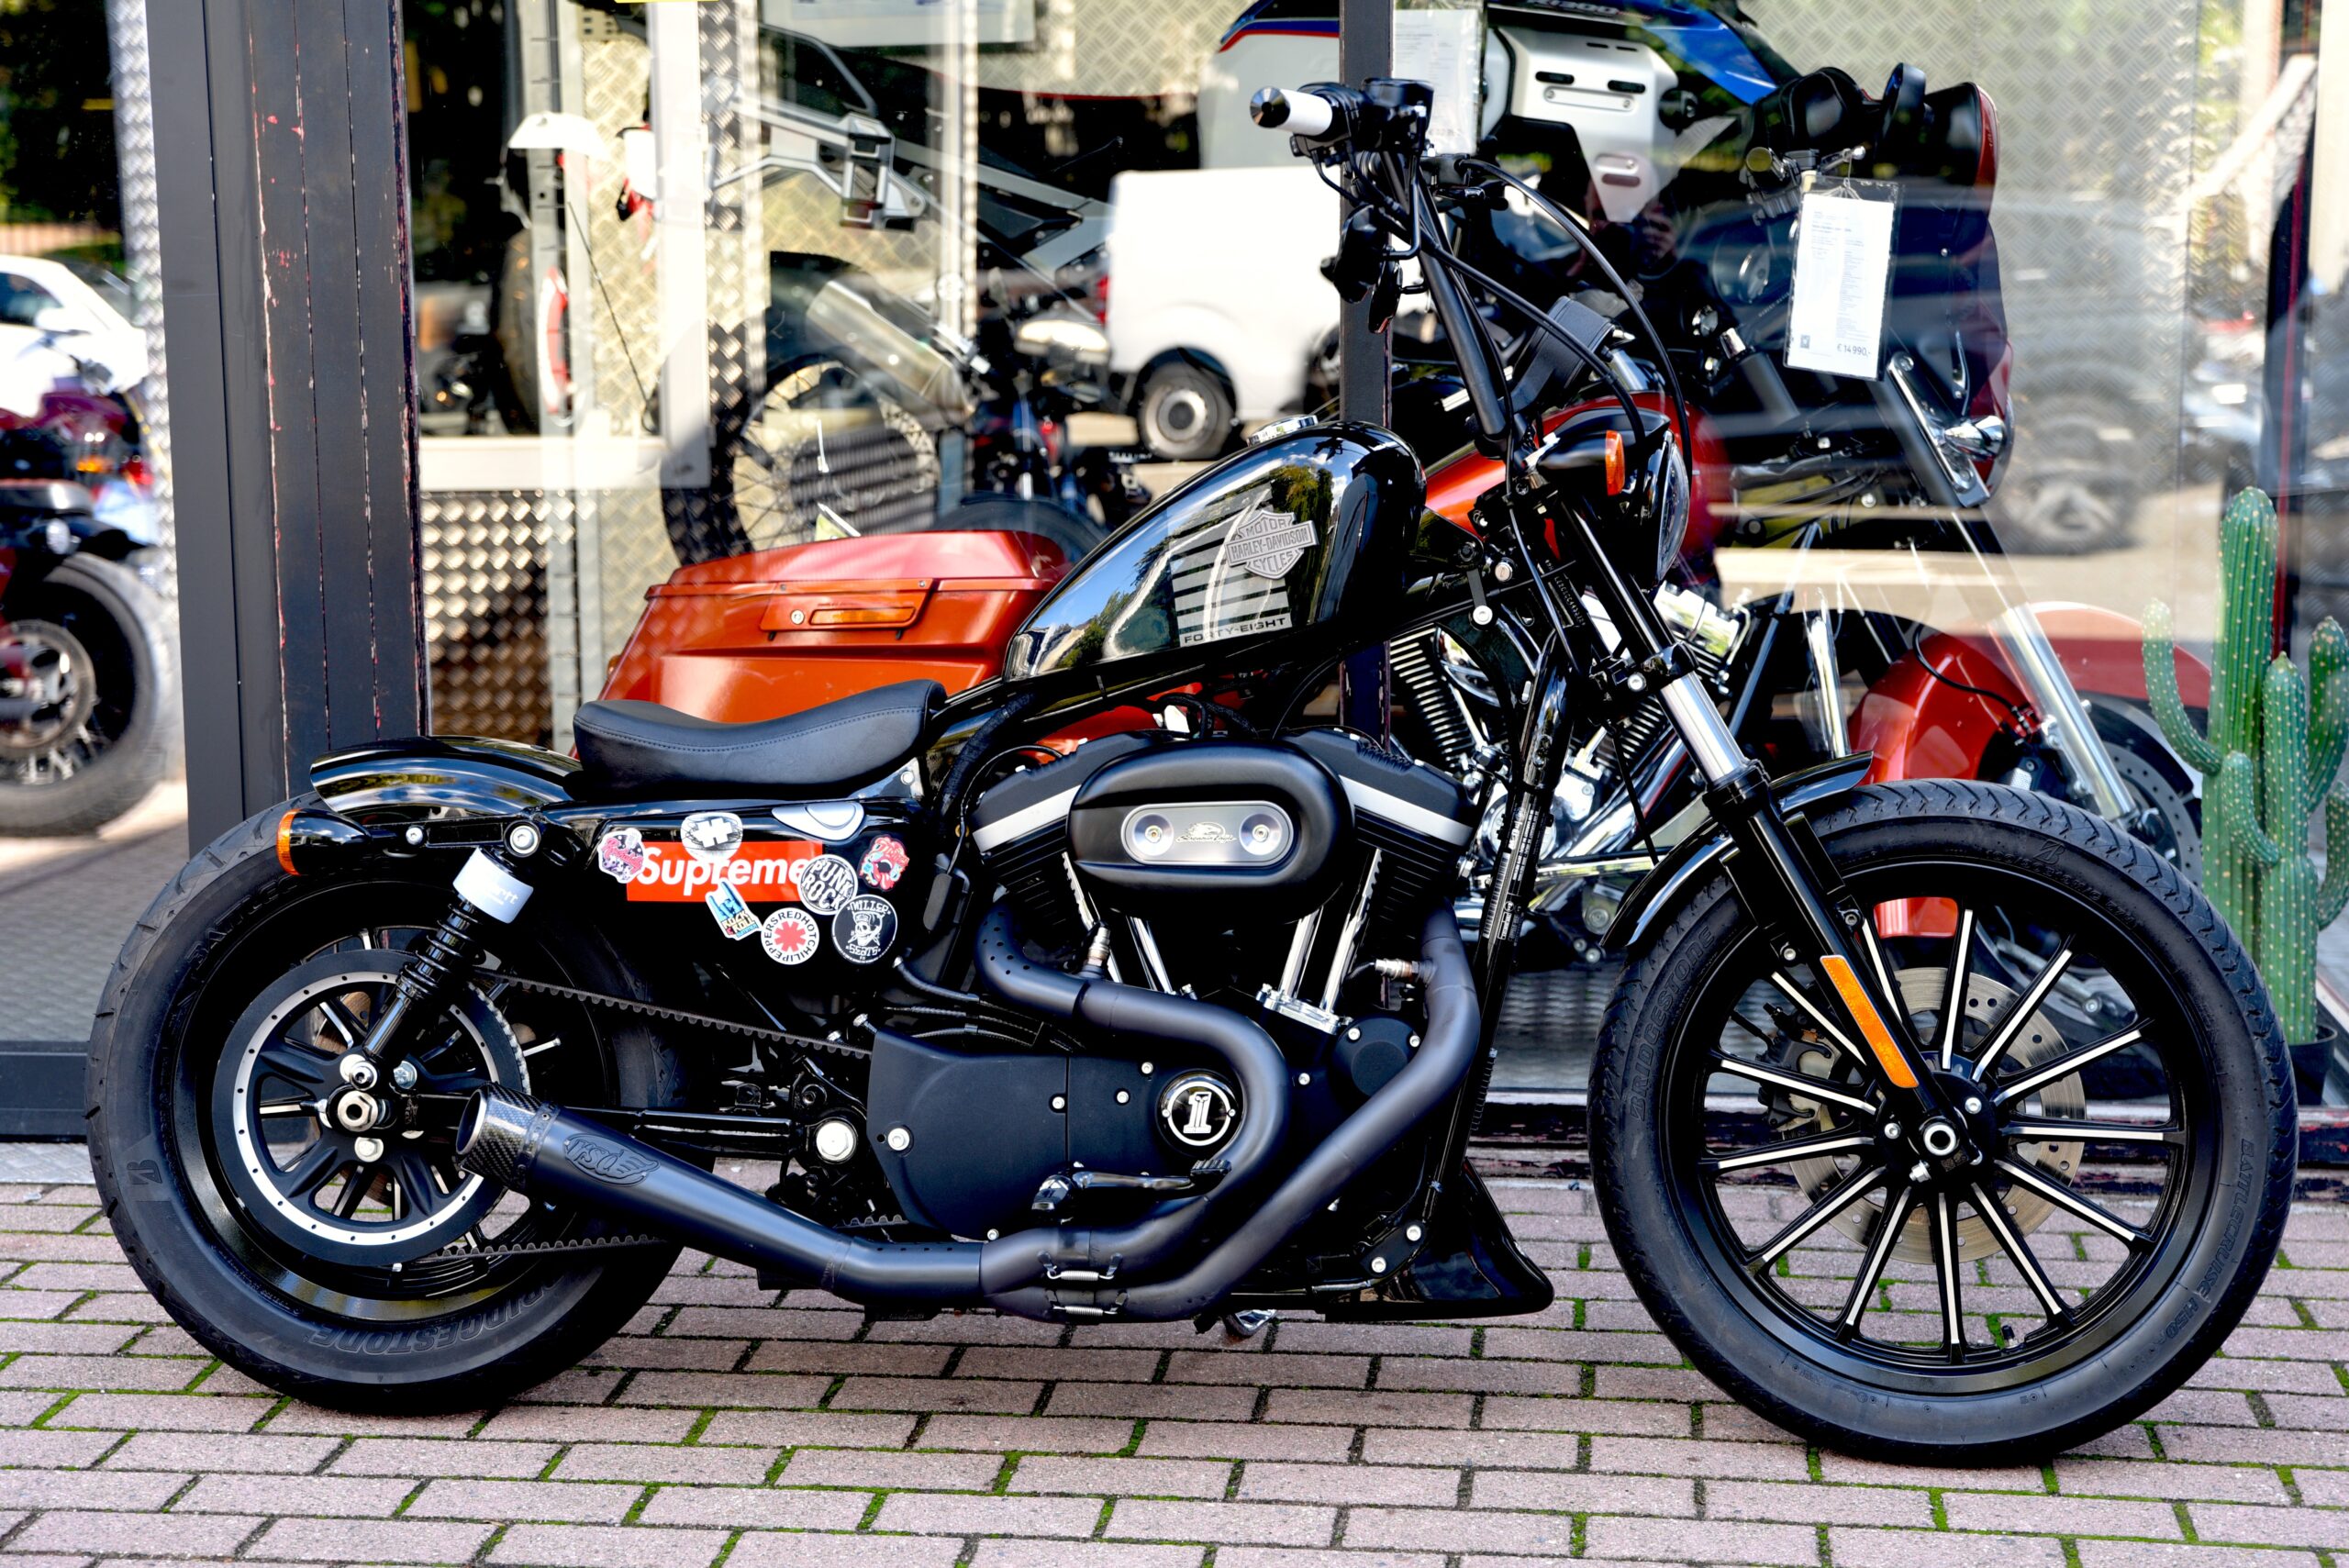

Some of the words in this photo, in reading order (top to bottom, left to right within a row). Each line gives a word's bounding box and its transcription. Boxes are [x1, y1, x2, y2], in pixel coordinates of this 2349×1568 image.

[1230, 526, 1309, 560] HARLEY-DAVIDSON
[1245, 517, 1290, 538] MOTOR
[1252, 550, 1295, 573] CYCLES
[638, 847, 810, 896] Supreme
[810, 859, 853, 898] PUNK
[801, 873, 845, 910] ROCK
[1630, 925, 1715, 1122] BRIDGESTONE
